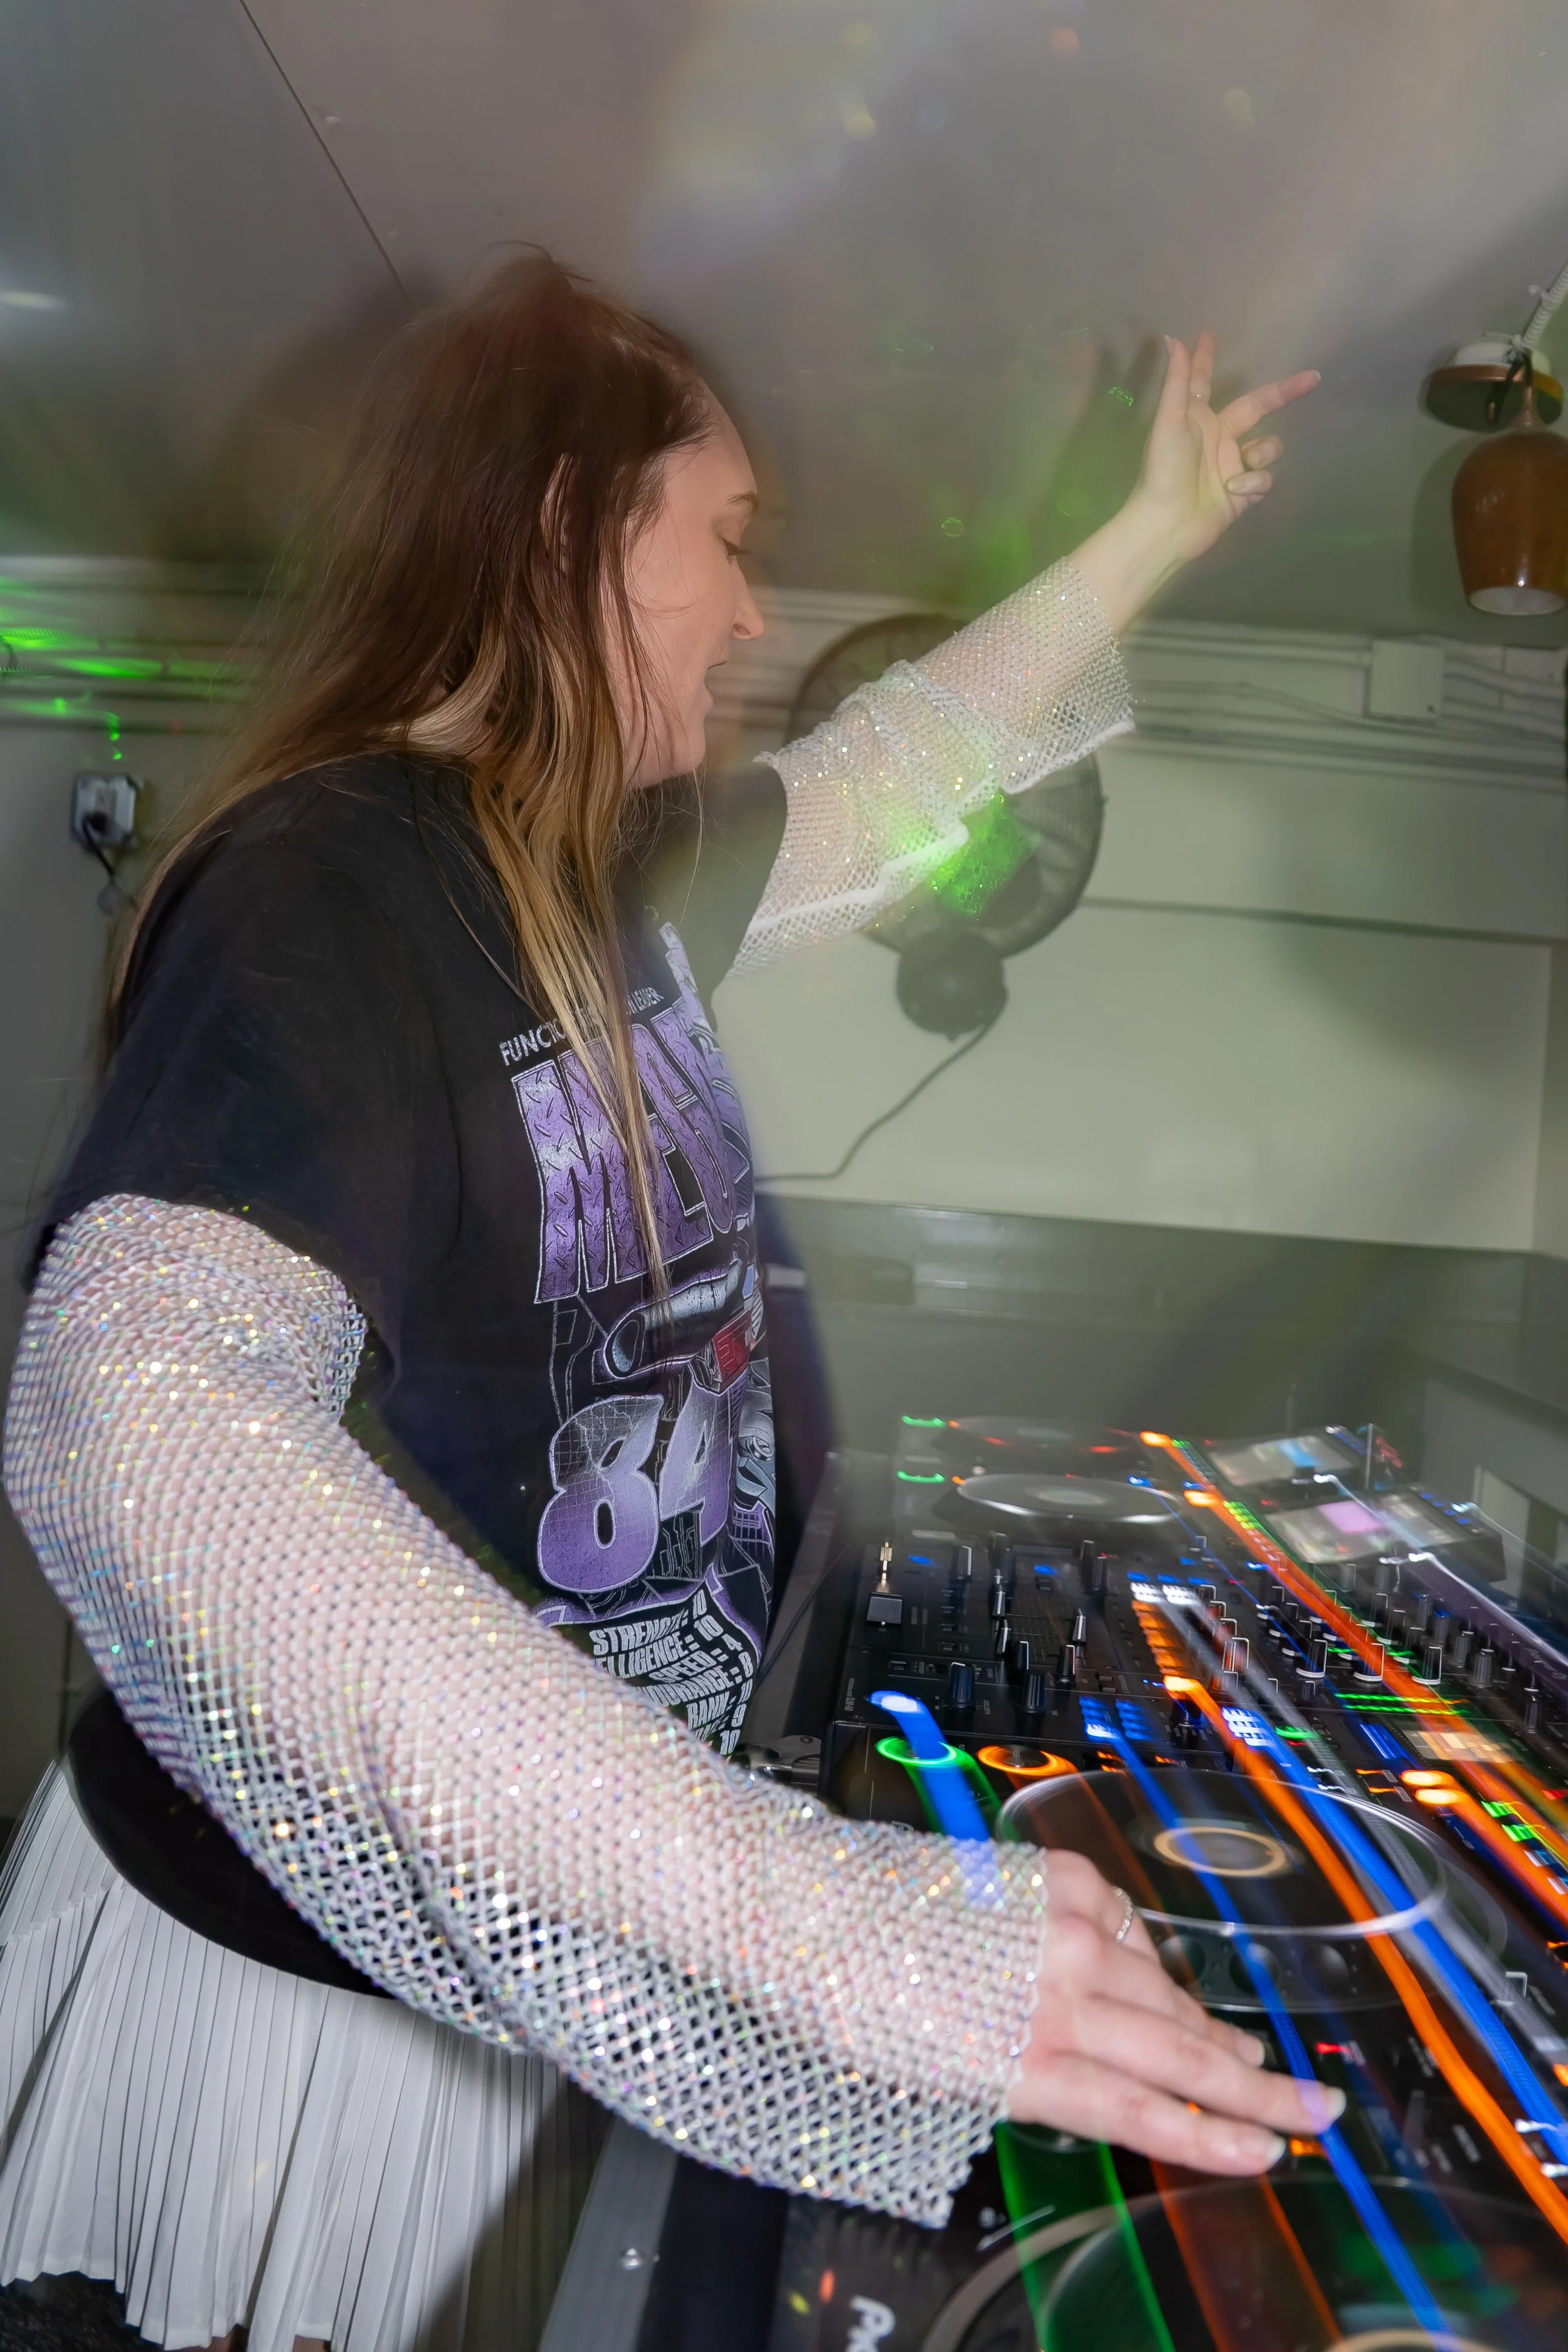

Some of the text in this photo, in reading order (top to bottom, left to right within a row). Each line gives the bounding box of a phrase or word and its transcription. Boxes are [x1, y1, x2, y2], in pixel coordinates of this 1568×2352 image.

[537, 1374, 733, 1594] 84
[692, 1589, 707, 1618] 10
[595, 1614, 724, 1679] ELLIGENCE: 10
[721, 1633, 744, 1653] 4
[738, 1651, 753, 1678] 8
[731, 1703, 747, 1727] 9
[719, 1729, 741, 1755] 10
